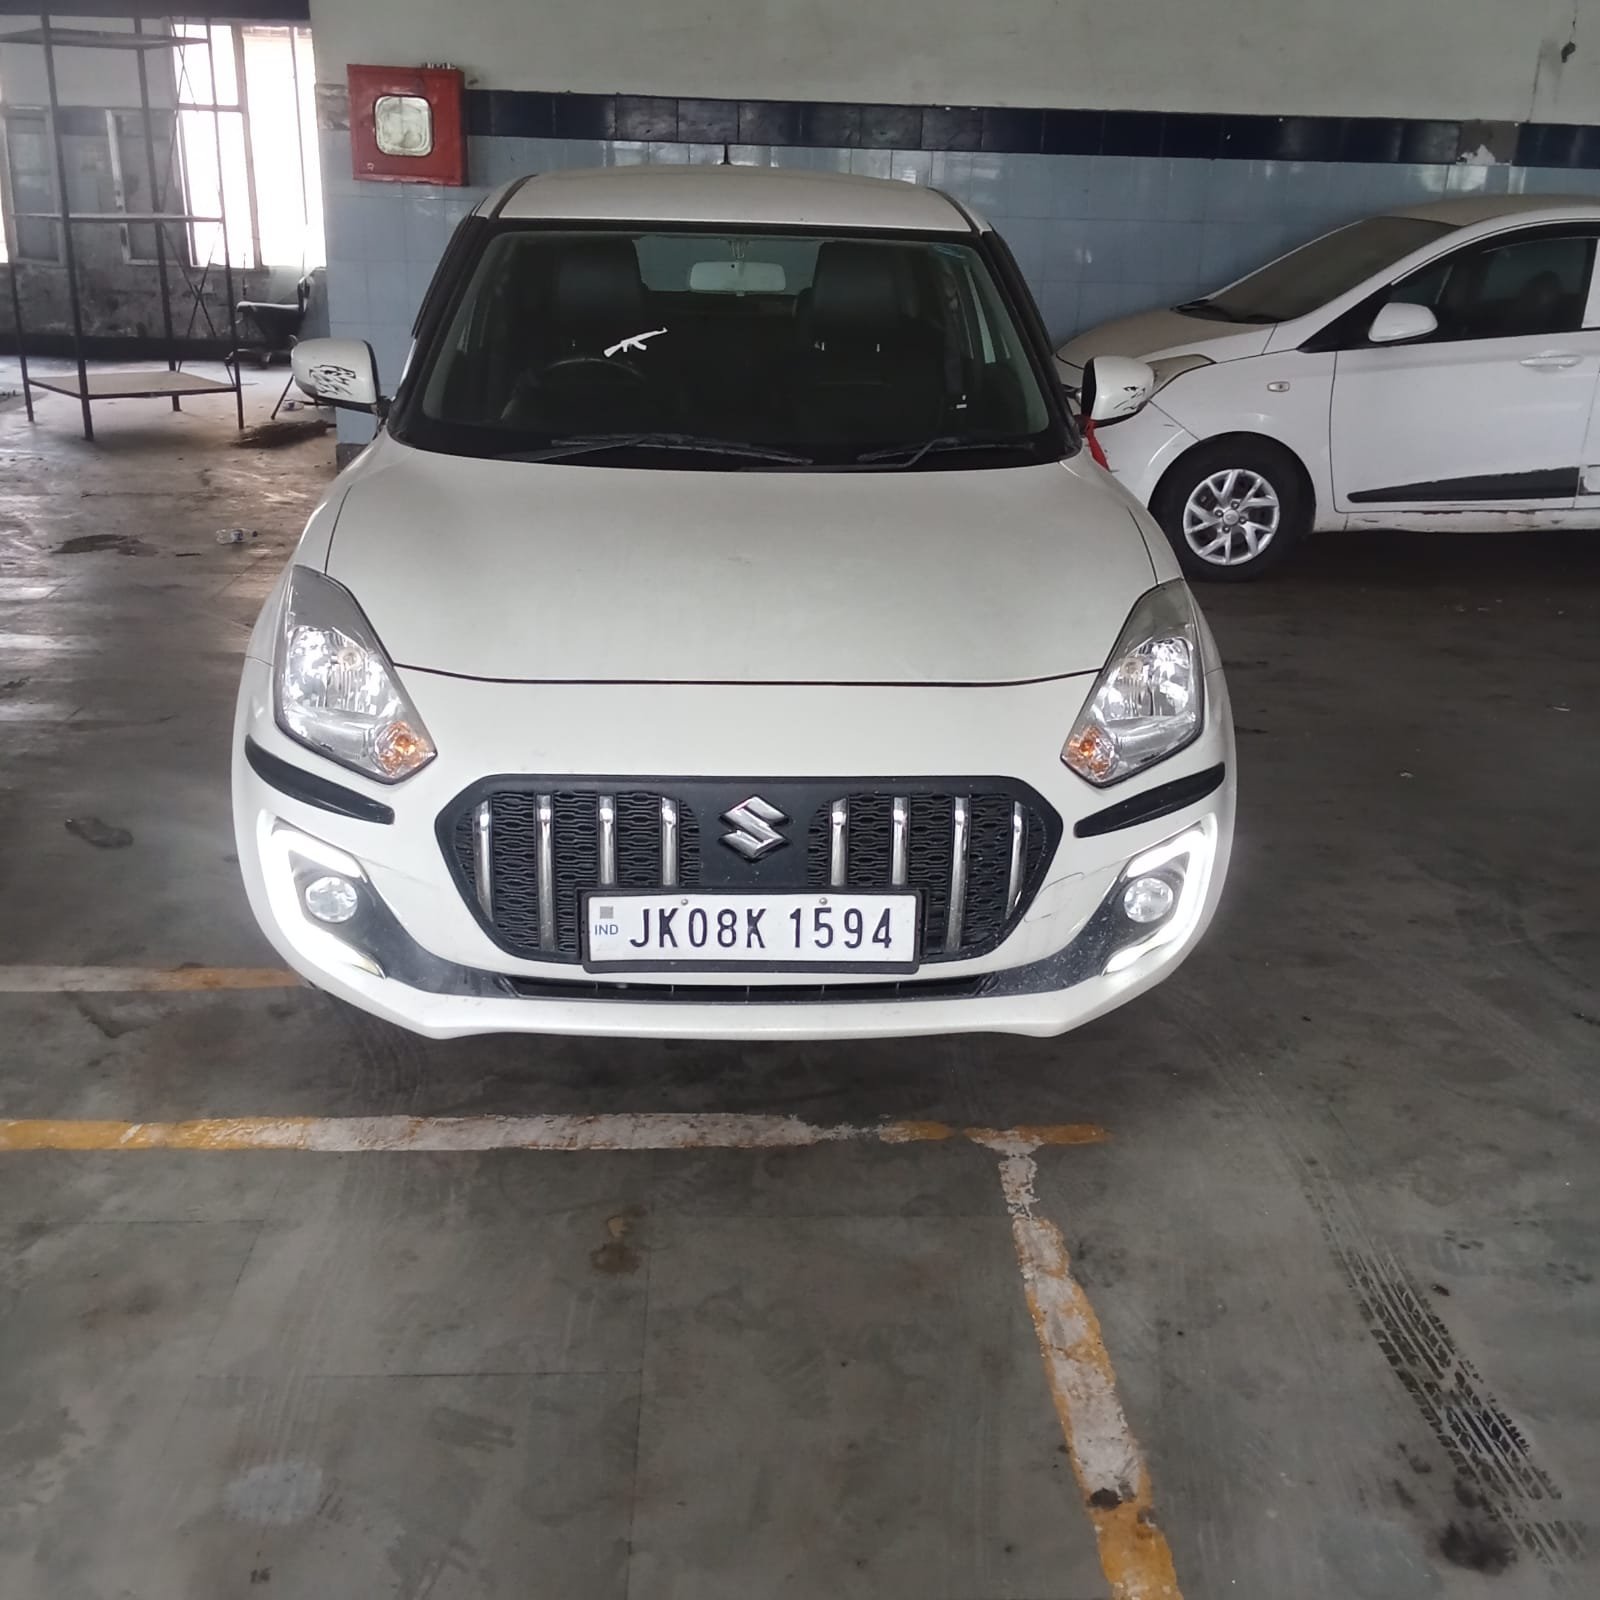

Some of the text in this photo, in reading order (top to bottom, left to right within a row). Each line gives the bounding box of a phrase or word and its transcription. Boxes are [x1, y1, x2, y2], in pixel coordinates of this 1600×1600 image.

[594, 924, 619, 936] IND
[629, 907, 892, 949] JK08K 1594
